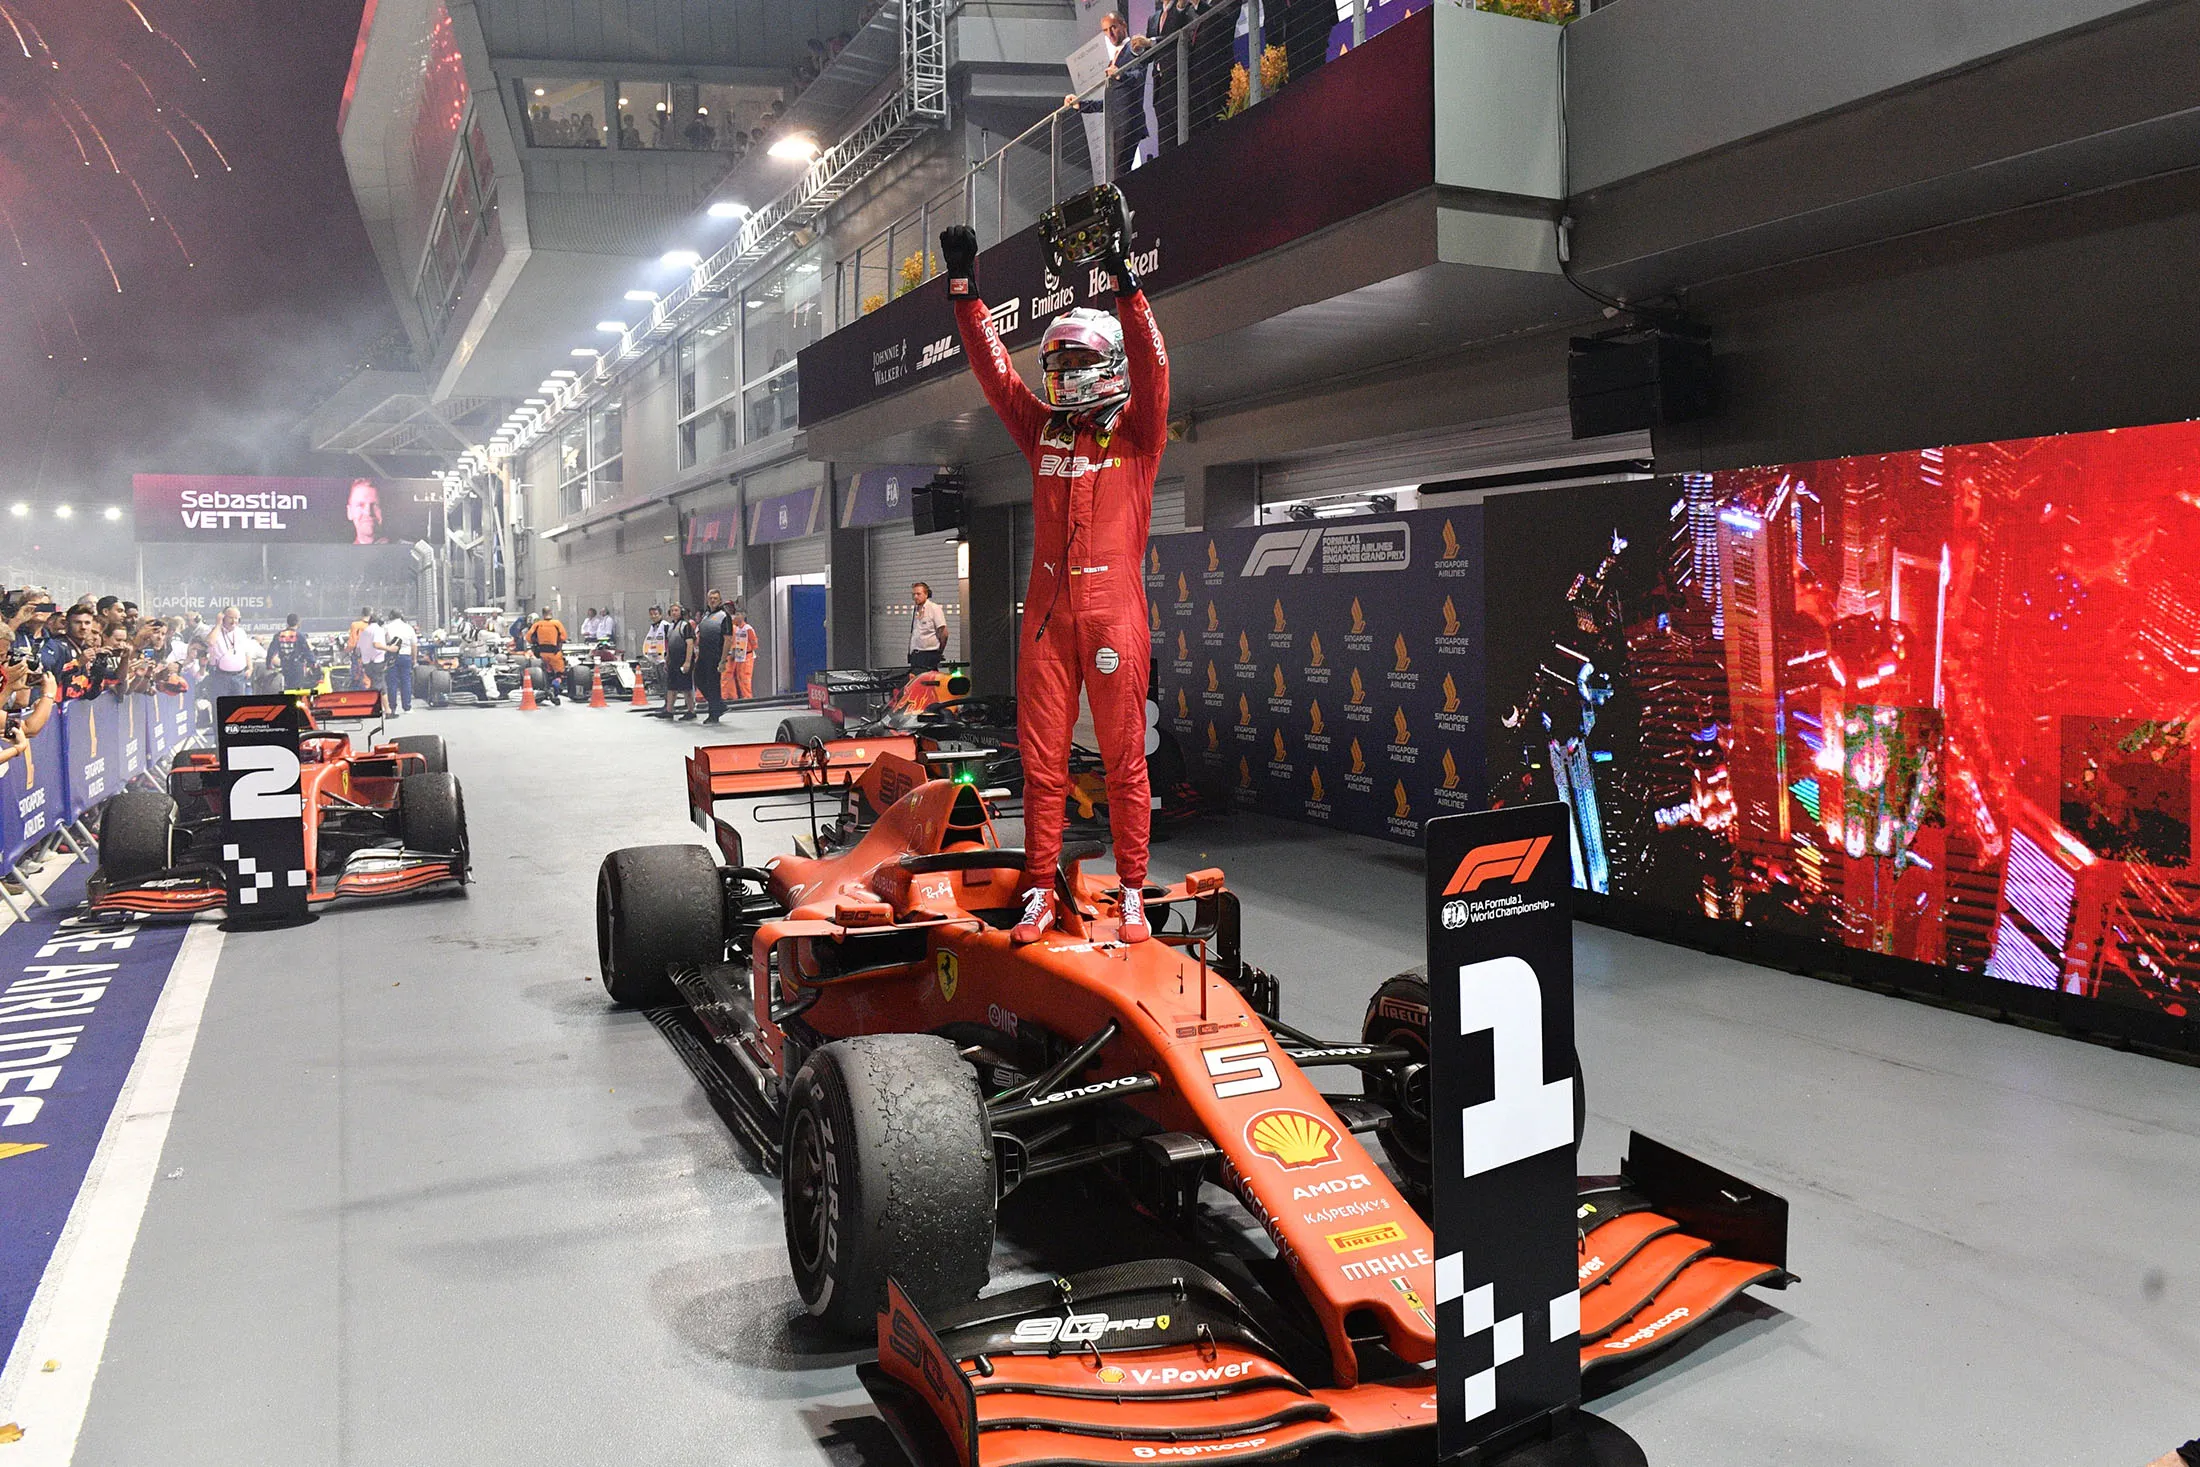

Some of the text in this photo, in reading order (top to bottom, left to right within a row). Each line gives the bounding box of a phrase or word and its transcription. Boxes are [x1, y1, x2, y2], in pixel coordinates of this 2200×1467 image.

[1032, 285, 1074, 320] Emirates
[1144, 307, 1166, 366] Lenovo
[872, 344, 899, 371] JOHNNIE
[918, 335, 957, 369] DHL
[874, 365, 900, 387] WALKER
[180, 490, 308, 510] Sebastian
[181, 511, 286, 529] VETTEL
[1322, 535, 1357, 546] FORMULA
[1322, 541, 1394, 555] SINGAPORE AIRLINES
[1322, 550, 1404, 564] SINGAPORE GRAND PRIX
[1435, 560, 1468, 569] SINGAPORE
[1438, 569, 1465, 578] AIRLINES
[209, 596, 264, 608] AIRLINES
[1268, 632, 1292, 641] SINGAPORE
[1344, 634, 1373, 643] SINGAPORE
[1435, 637, 1469, 646] SINGAPORE
[1271, 640, 1290, 648] AIRLINES
[1347, 643, 1370, 651] AIRLINES
[1438, 647, 1466, 655] AIRLINES
[1304, 667, 1331, 676] SINGAPORE
[1387, 672, 1419, 681] SINGAPORE
[1307, 676, 1329, 684] AIRLINES
[1390, 681, 1416, 690] AIRLINES
[810, 688, 826, 701] ESSO
[1268, 697, 1292, 706] SINGAPORE
[1270, 706, 1290, 714] AIRLINES
[1343, 704, 1373, 713] SINGAPORE
[1346, 713, 1370, 722] AIRLINES
[1434, 713, 1469, 722] SINGAPORE
[1438, 722, 1466, 732] AIRLINES
[959, 732, 1001, 746] ASTON MARTIN
[1304, 734, 1331, 744] SINGAPORE
[1307, 743, 1329, 752] AIRLINES
[1387, 745, 1419, 755] SINGAPORE
[1390, 754, 1416, 764] AIRLINES
[227, 745, 301, 820] 2
[1344, 774, 1373, 785] SINGAPORE
[1347, 783, 1370, 793] AIRLINES
[1433, 788, 1468, 800] SINGAPORE
[1304, 801, 1332, 812] SINGAPORE
[1437, 799, 1465, 810] AIRLINES
[1307, 809, 1329, 820] AIRLINES
[1387, 817, 1419, 829] SINGAPORE
[1390, 826, 1416, 838] AIRLINES
[1470, 894, 1523, 912] FIA Formula 1
[1470, 910, 1494, 923] World
[1495, 900, 1549, 917] Championship
[1379, 996, 1429, 1027] PIRELLI
[1290, 1047, 1372, 1059] Lenovo
[1201, 1039, 1282, 1099] 5
[1459, 956, 1574, 1178] 1
[1030, 1076, 1139, 1107] Lenovo
[810, 1083, 839, 1263] P ZERO
[1293, 1178, 1348, 1200] AMD
[1303, 1199, 1380, 1225] KASPERSKY
[1333, 1227, 1398, 1249] PIRELLI
[1340, 1248, 1433, 1281] MAHLE
[1010, 1313, 1157, 1344] 90 YEARS
[1131, 1360, 1253, 1384] V-Power
[1158, 1437, 1267, 1456] eightcap
